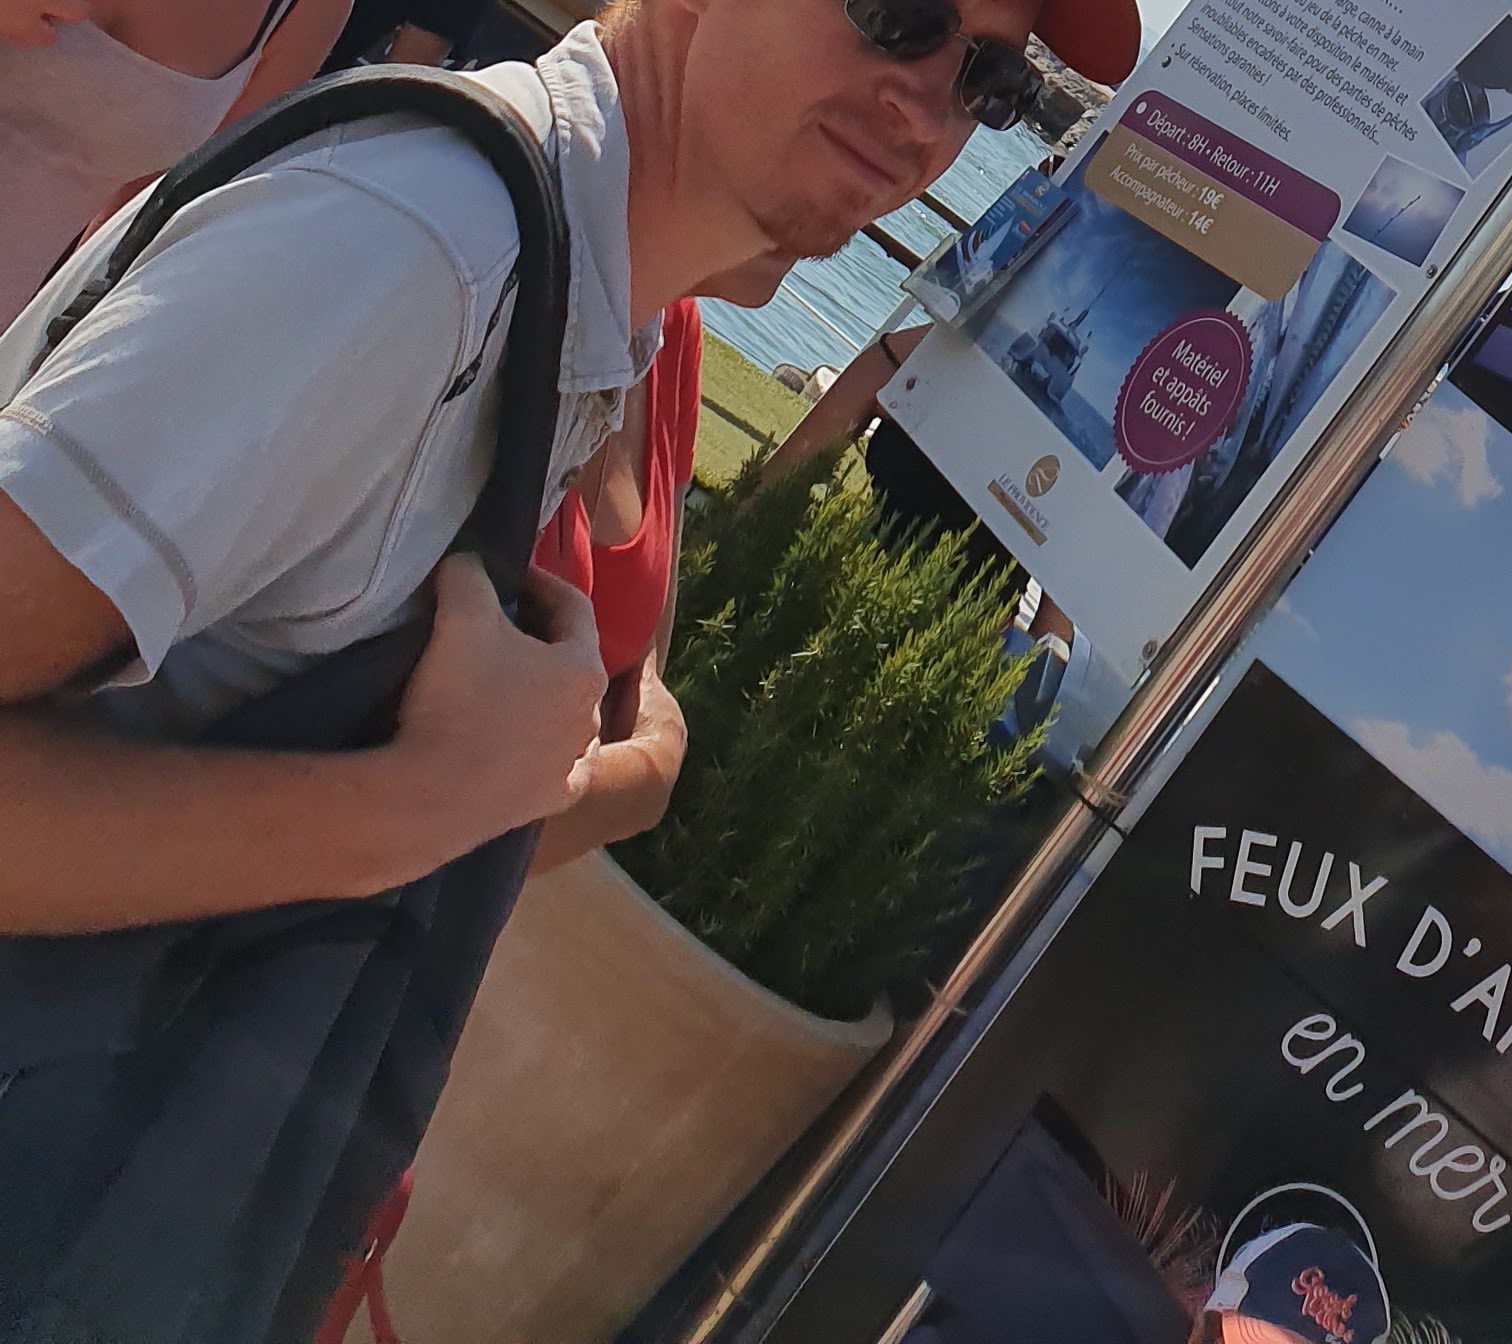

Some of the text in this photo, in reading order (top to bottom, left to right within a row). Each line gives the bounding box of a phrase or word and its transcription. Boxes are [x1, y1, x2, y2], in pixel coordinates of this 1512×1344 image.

[1199, 0, 1249, 43] inoubliables
[1244, 35, 1289, 73] encadrées
[1281, 65, 1303, 84] par
[1298, 73, 1319, 96] des
[1318, 7, 1334, 24] de
[1330, 14, 1343, 31] la
[1336, 23, 1369, 50] pêche
[1356, 10, 1387, 35] canne
[1382, 25, 1395, 40] à
[1390, 29, 1403, 46] la
[1398, 38, 1425, 63] main
[1174, 42, 1193, 61] Sur
[1228, 88, 1260, 116] places
[1186, 16, 1231, 56] Sensations
[1224, 49, 1266, 84] garanties
[1239, 6, 1266, 30] notre
[1260, 21, 1308, 61] savoir-faire
[1301, 52, 1329, 75] pour
[1324, 66, 1345, 87] des
[1338, 79, 1374, 109] parties
[1369, 99, 1387, 118] de
[1379, 109, 1419, 143] pêches
[1277, 4, 1289, 18] à
[1283, 10, 1309, 34] votre
[1304, 25, 1354, 66] disposition
[1349, 55, 1363, 73] le
[1358, 64, 1400, 98] matériel
[1394, 91, 1409, 106] et
[1365, 43, 1380, 58] en
[1123, 142, 1145, 163] Prix
[1138, 156, 1159, 173] par
[1197, 185, 1224, 210] 19€
[1145, 108, 1187, 143] Départ
[1187, 133, 1209, 154] 8H
[1209, 145, 1250, 179] Retour
[1251, 170, 1280, 197] 11H
[1108, 164, 1183, 219] Accompagnateur
[1186, 209, 1214, 234] 14€
[1151, 365, 1212, 417] et appâts
[1171, 339, 1229, 388] Matériel
[1139, 389, 1186, 436] fournis
[1188, 824, 1389, 948] FEUX
[1280, 1010, 1512, 1234] en mer
